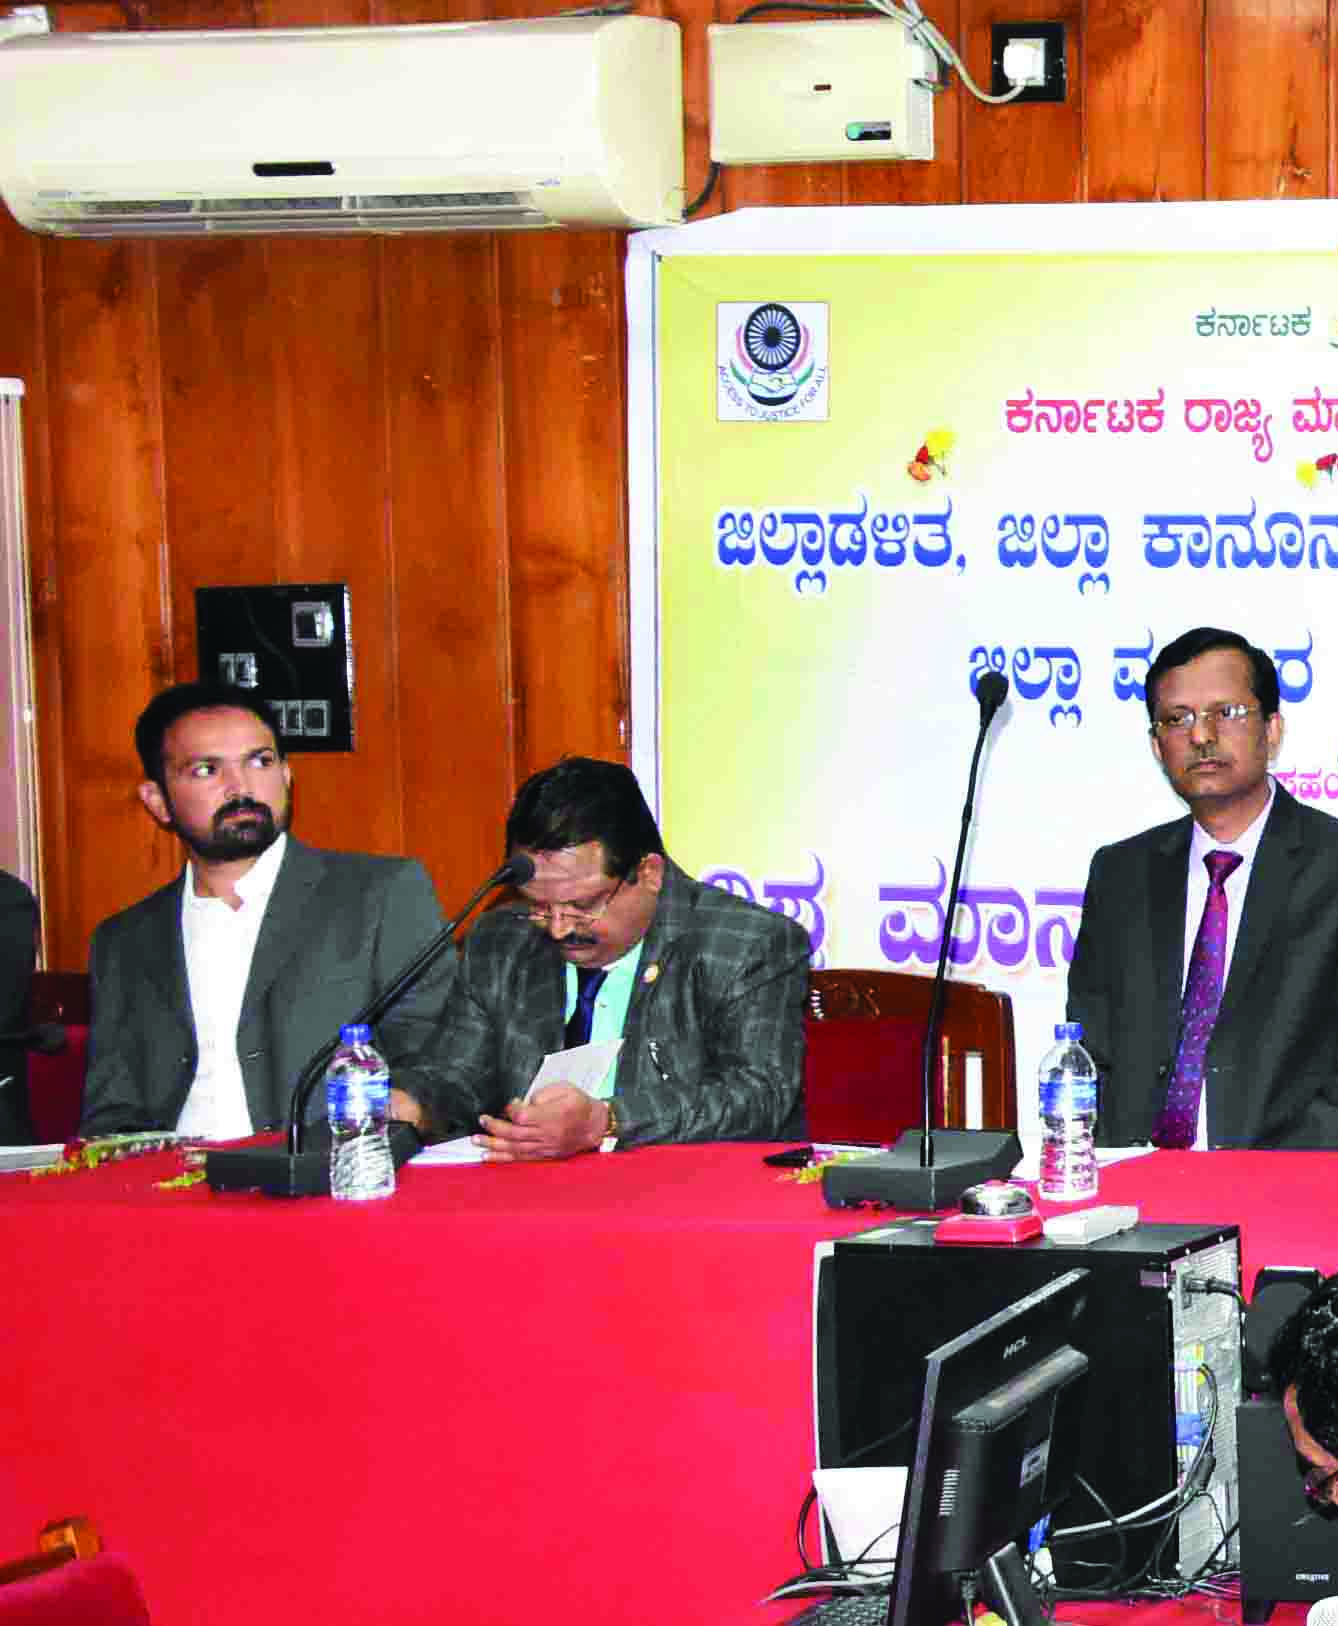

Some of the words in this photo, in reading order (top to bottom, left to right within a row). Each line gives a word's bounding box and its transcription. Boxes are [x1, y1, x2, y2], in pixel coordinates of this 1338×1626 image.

[1195, 306, 1312, 337] ಕರ್ನಾಟಕ
[1005, 388, 1164, 433] ಕರ್ನಾಟಕ
[1184, 388, 1274, 462] ರಾಜ್ಯ
[717, 494, 966, 595] ಜಿಲ್ಲಾಡಳಿತ,
[997, 511, 1111, 595] ಜಿಲ್ಲಾ
